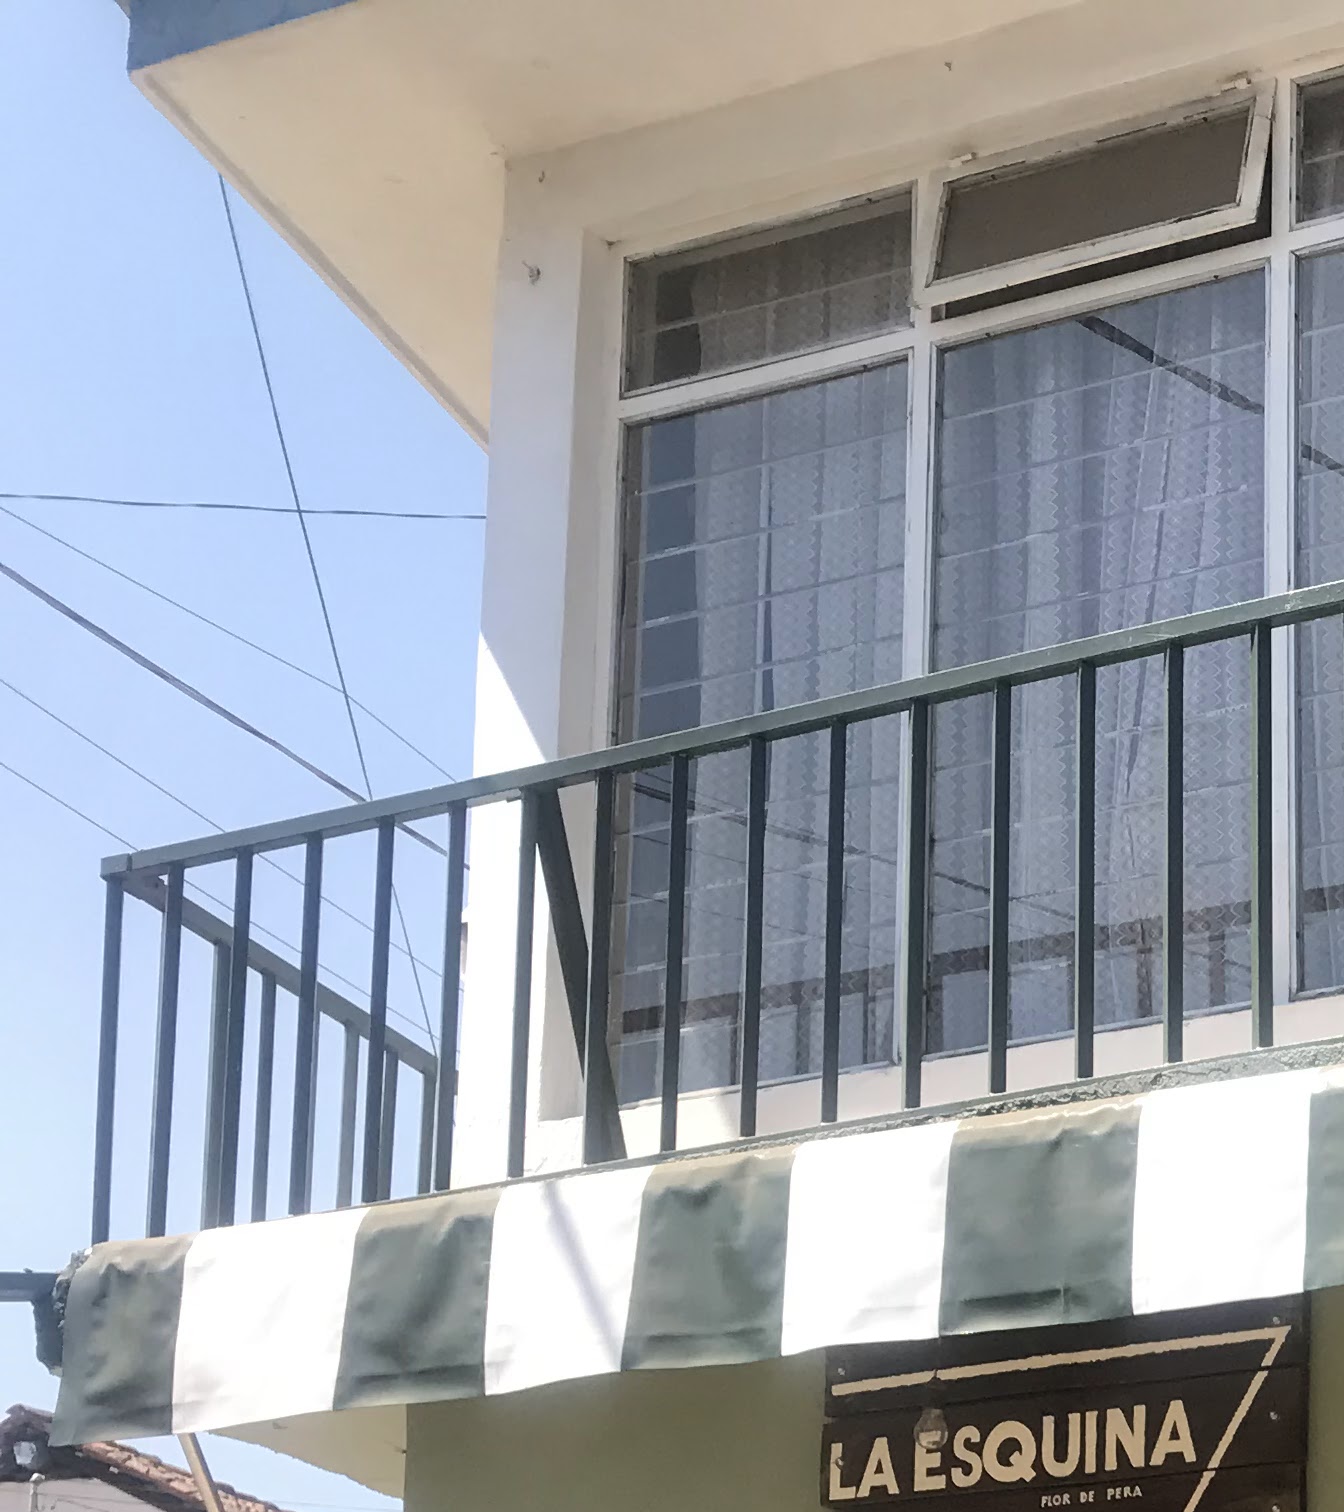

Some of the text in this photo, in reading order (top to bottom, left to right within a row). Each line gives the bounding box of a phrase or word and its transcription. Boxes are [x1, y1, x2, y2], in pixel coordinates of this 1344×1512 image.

[828, 1399, 1197, 1501] LA ESQUINA
[1040, 1485, 1143, 1509] FLOR DE PERA
